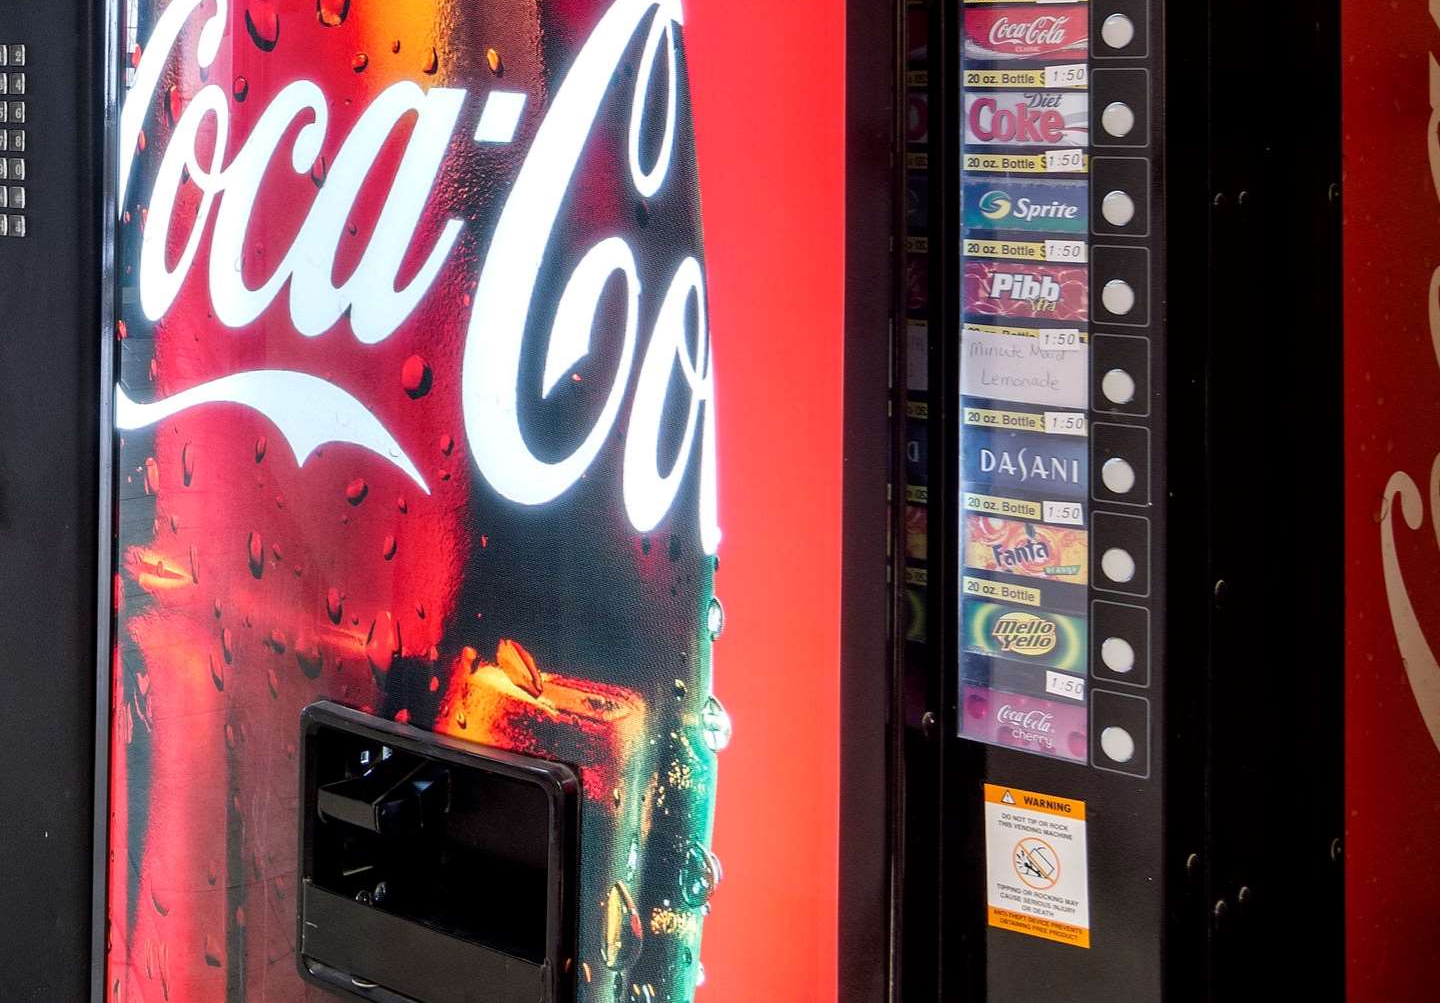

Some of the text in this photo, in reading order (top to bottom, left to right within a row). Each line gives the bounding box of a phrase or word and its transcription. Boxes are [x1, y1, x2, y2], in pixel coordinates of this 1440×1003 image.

[15, 51, 21, 62] 2
[15, 79, 21, 90] 4
[966, 74, 981, 84] 20
[1002, 72, 1035, 84] Bottle
[1024, 93, 1063, 108] Diet
[15, 107, 21, 119] 6
[969, 97, 1064, 143] Coke
[15, 136, 21, 148] 8
[15, 164, 21, 175] 0
[966, 158, 981, 168] 20
[1002, 158, 1035, 169] Bottle
[1013, 197, 1078, 221] Sprite
[966, 243, 981, 253] 20
[1002, 244, 1035, 256] Bottle
[990, 273, 1060, 302] Pibb
[969, 341, 1025, 359] Minute
[980, 368, 1061, 391] Lemonade
[966, 412, 981, 422] 20
[1002, 415, 1035, 428] Bottle
[980, 447, 1079, 484] DASANI
[966, 496, 981, 508] 20
[1002, 501, 1035, 516] Bottle
[991, 539, 1051, 568] Fanta
[966, 580, 981, 592] 20
[1002, 586, 1035, 603] Bottle
[994, 618, 1054, 635] Mello
[1002, 632, 1054, 650] Yello
[1011, 727, 1054, 748] cherry
[1023, 795, 1072, 813] WARNING
[998, 820, 1073, 841] THIS VENDING MACHINE
[1001, 812, 1012, 821] DO
[1013, 814, 1026, 823] NOT
[1027, 817, 1038, 825] TIP
[1050, 822, 1069, 831] ROCK
[997, 883, 1079, 907] TIPPING OR ROCKING MAY
[1000, 892, 1021, 902] CAUSE
[1023, 897, 1052, 909] SERIOUS
[1021, 904, 1055, 917] OR DEATH
[1048, 928, 1078, 941] PRODUCT
